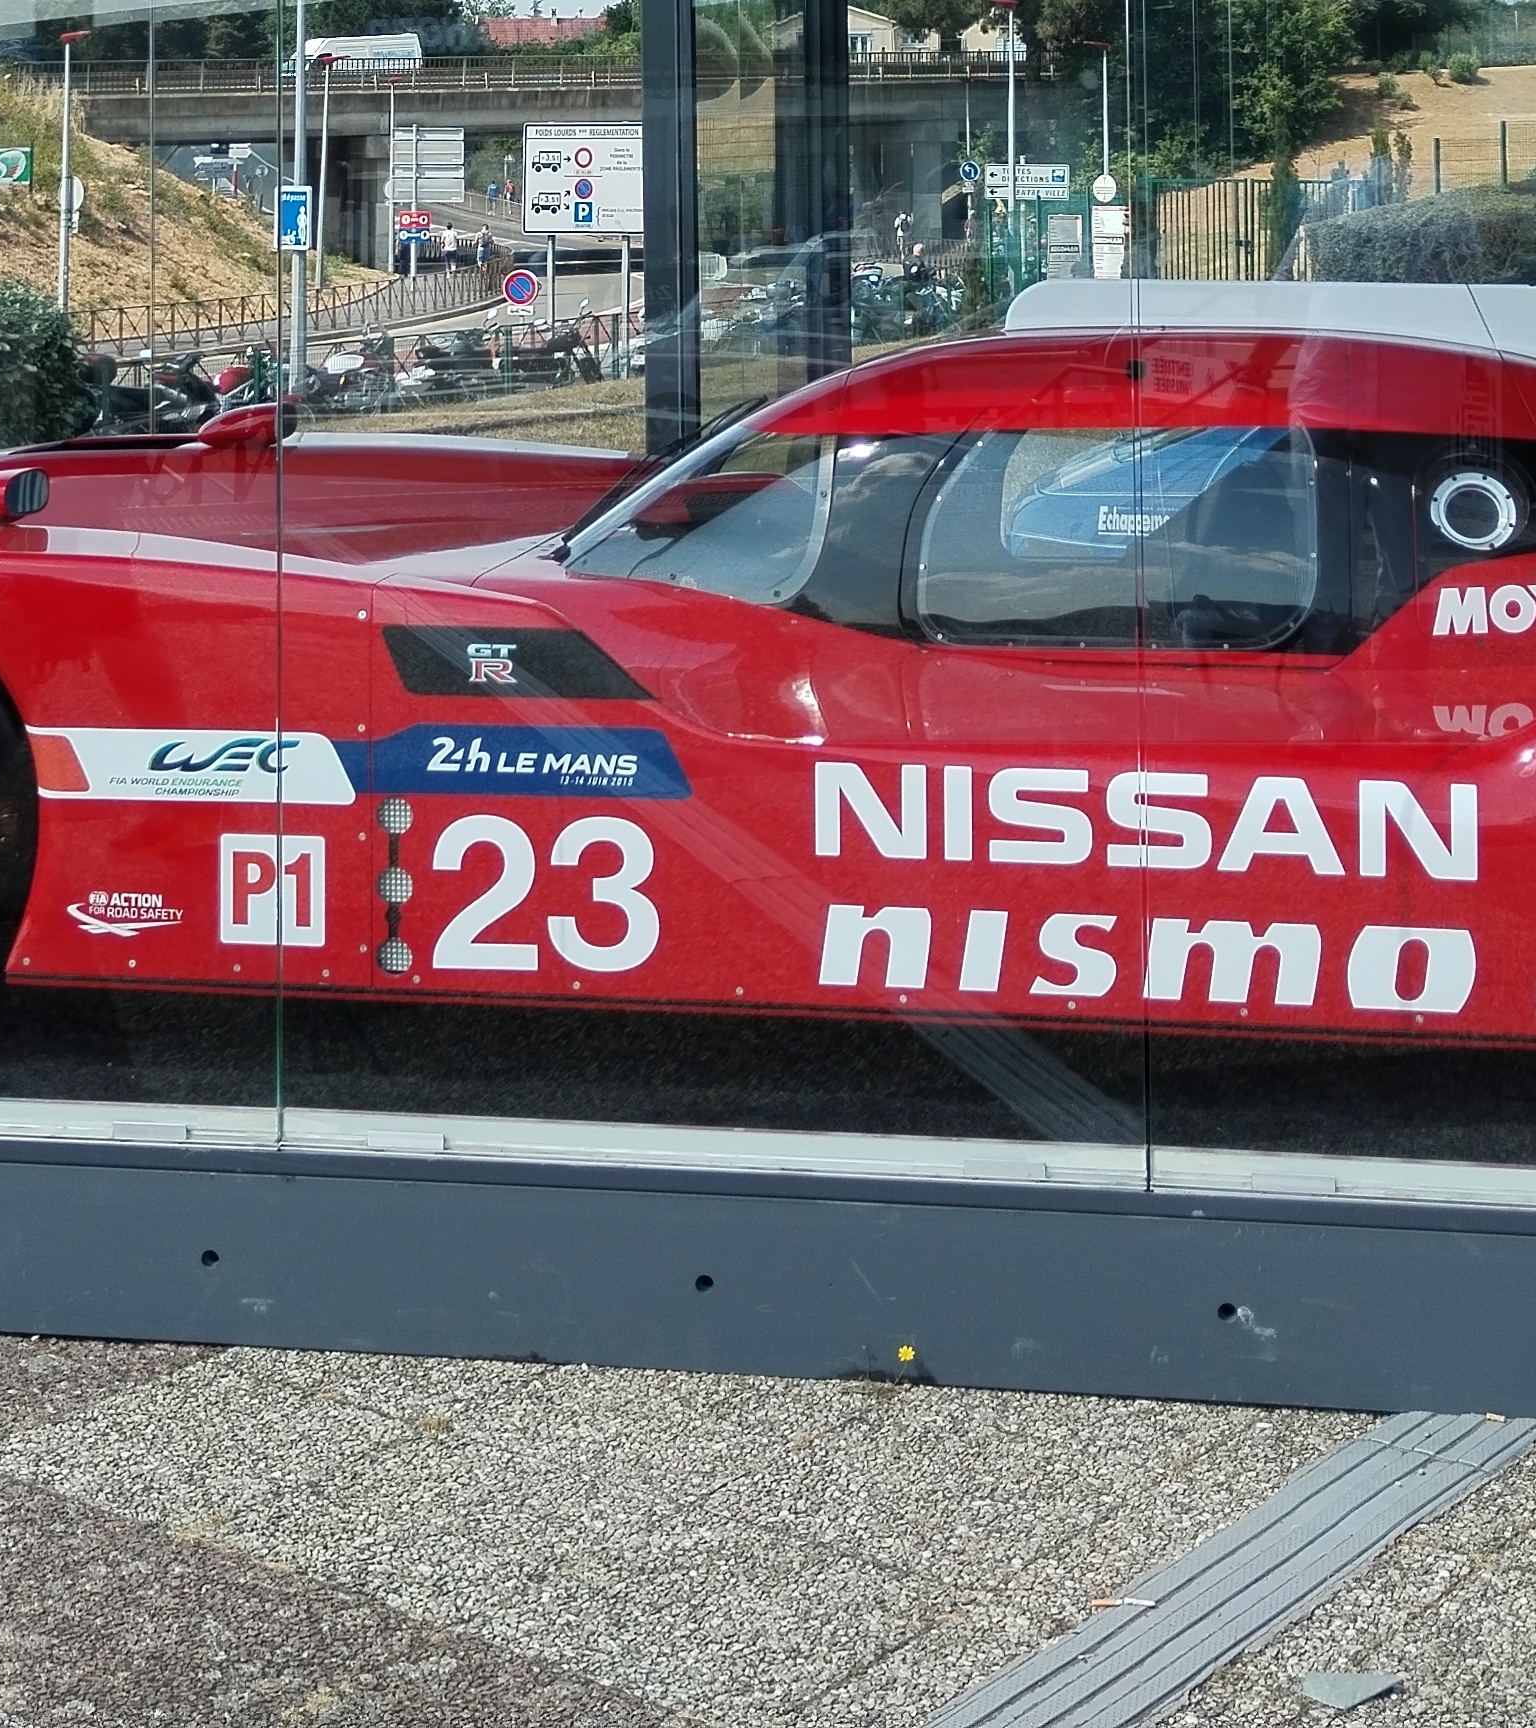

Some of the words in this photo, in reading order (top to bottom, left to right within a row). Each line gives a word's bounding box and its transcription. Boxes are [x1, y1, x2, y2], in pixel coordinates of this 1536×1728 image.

[1045, 189, 1066, 197] VILLE
[467, 643, 517, 659] GT
[469, 657, 517, 684] R
[148, 737, 300, 773] WEC
[427, 736, 491, 772] 24h
[497, 752, 538, 773] LE
[542, 753, 638, 775] MANS
[109, 776, 128, 786] FIA
[130, 777, 170, 787] WORLD
[171, 778, 243, 788] ENDURANCE
[154, 787, 240, 797] CHAMPIONSHIP
[586, 776, 608, 786] JUIN
[611, 776, 634, 787] 2015
[813, 760, 1478, 882] NISSAN
[232, 850, 312, 928] P1
[432, 813, 661, 972] 23
[89, 892, 108, 904] FIA
[110, 892, 163, 908] ACTION
[89, 906, 105, 915] FOR
[107, 907, 138, 919] ROAD
[140, 908, 183, 920] SAFETY
[818, 902, 1477, 1014] nismo
